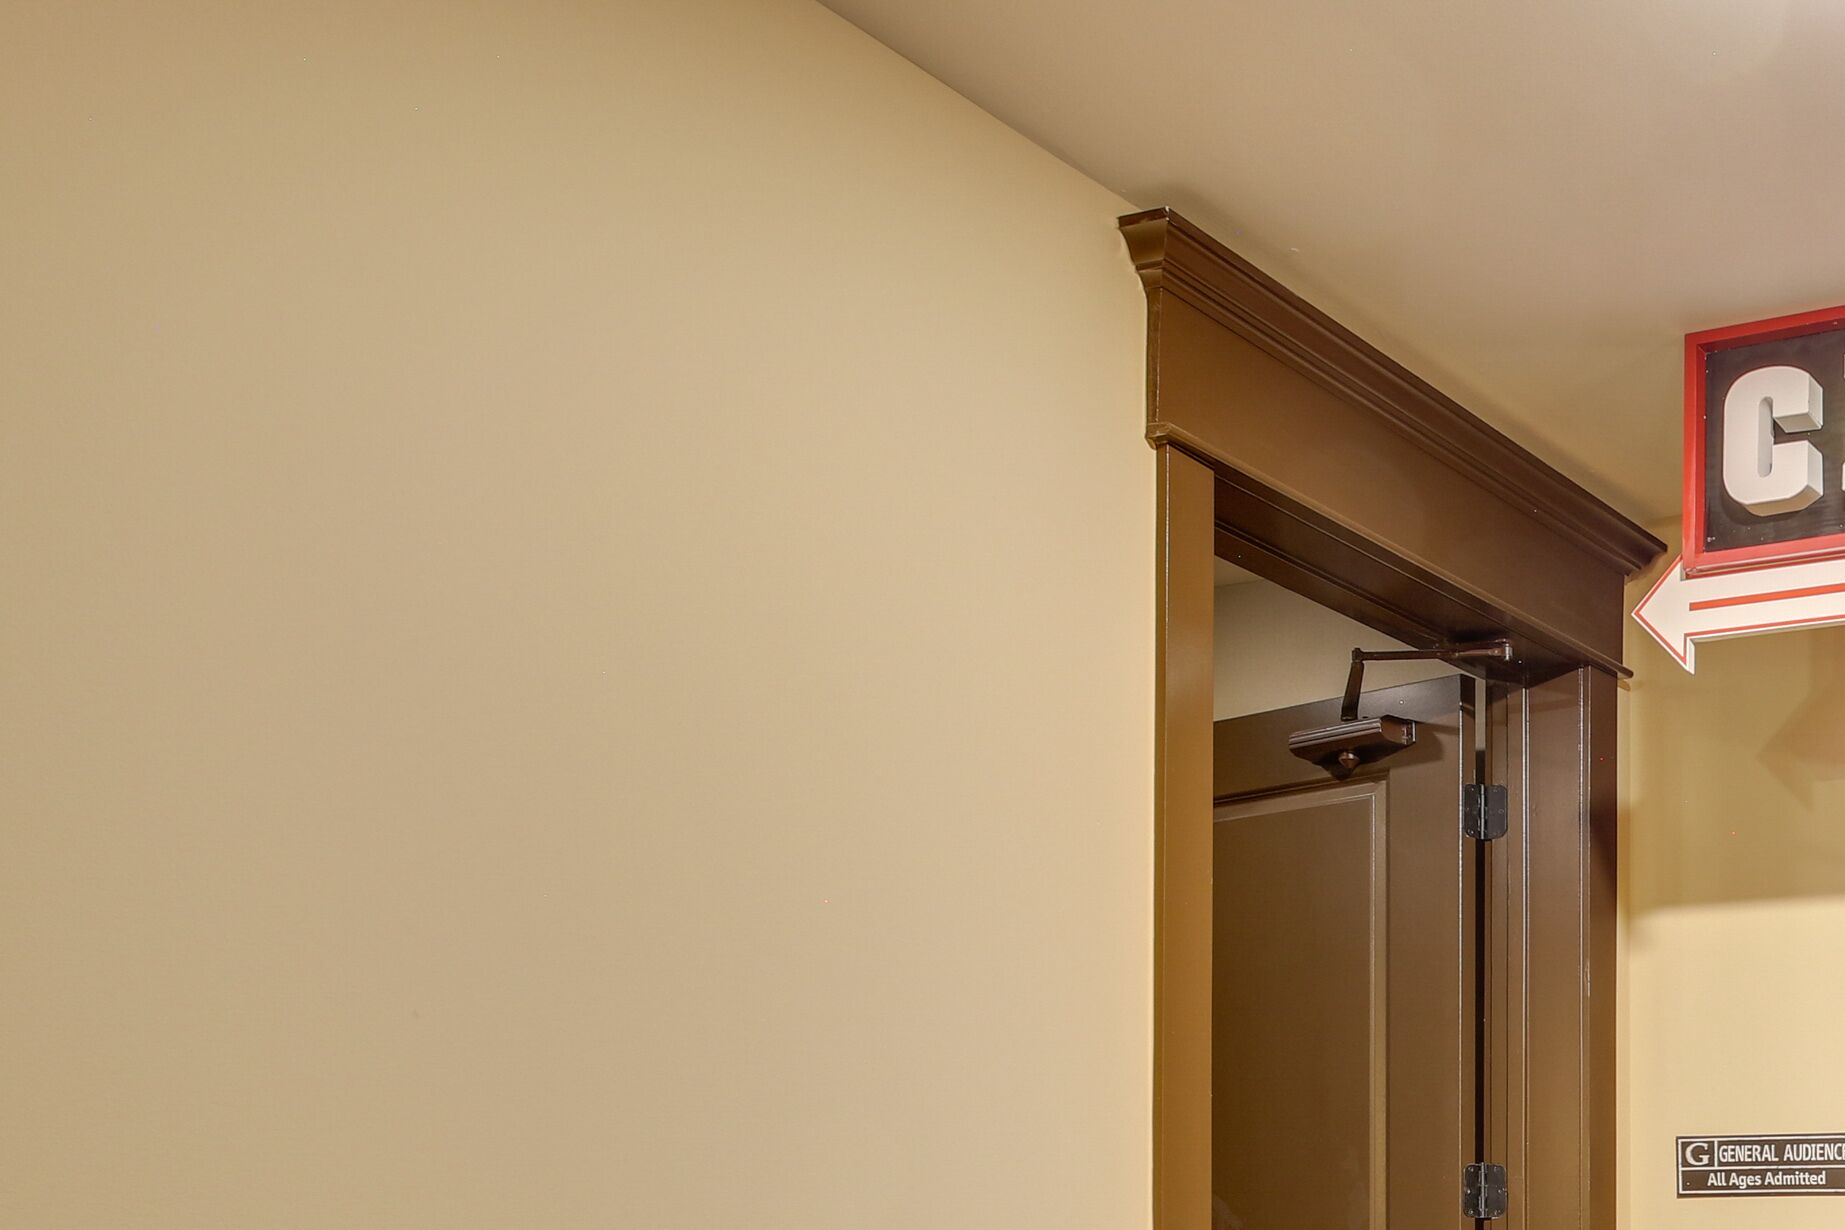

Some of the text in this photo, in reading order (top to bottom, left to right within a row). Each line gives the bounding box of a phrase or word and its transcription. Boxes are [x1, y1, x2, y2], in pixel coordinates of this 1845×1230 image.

[1685, 1143, 1710, 1165] G
[1719, 1144, 1779, 1162] GENERAL
[1707, 1171, 1826, 1189] All Ages Admitted
